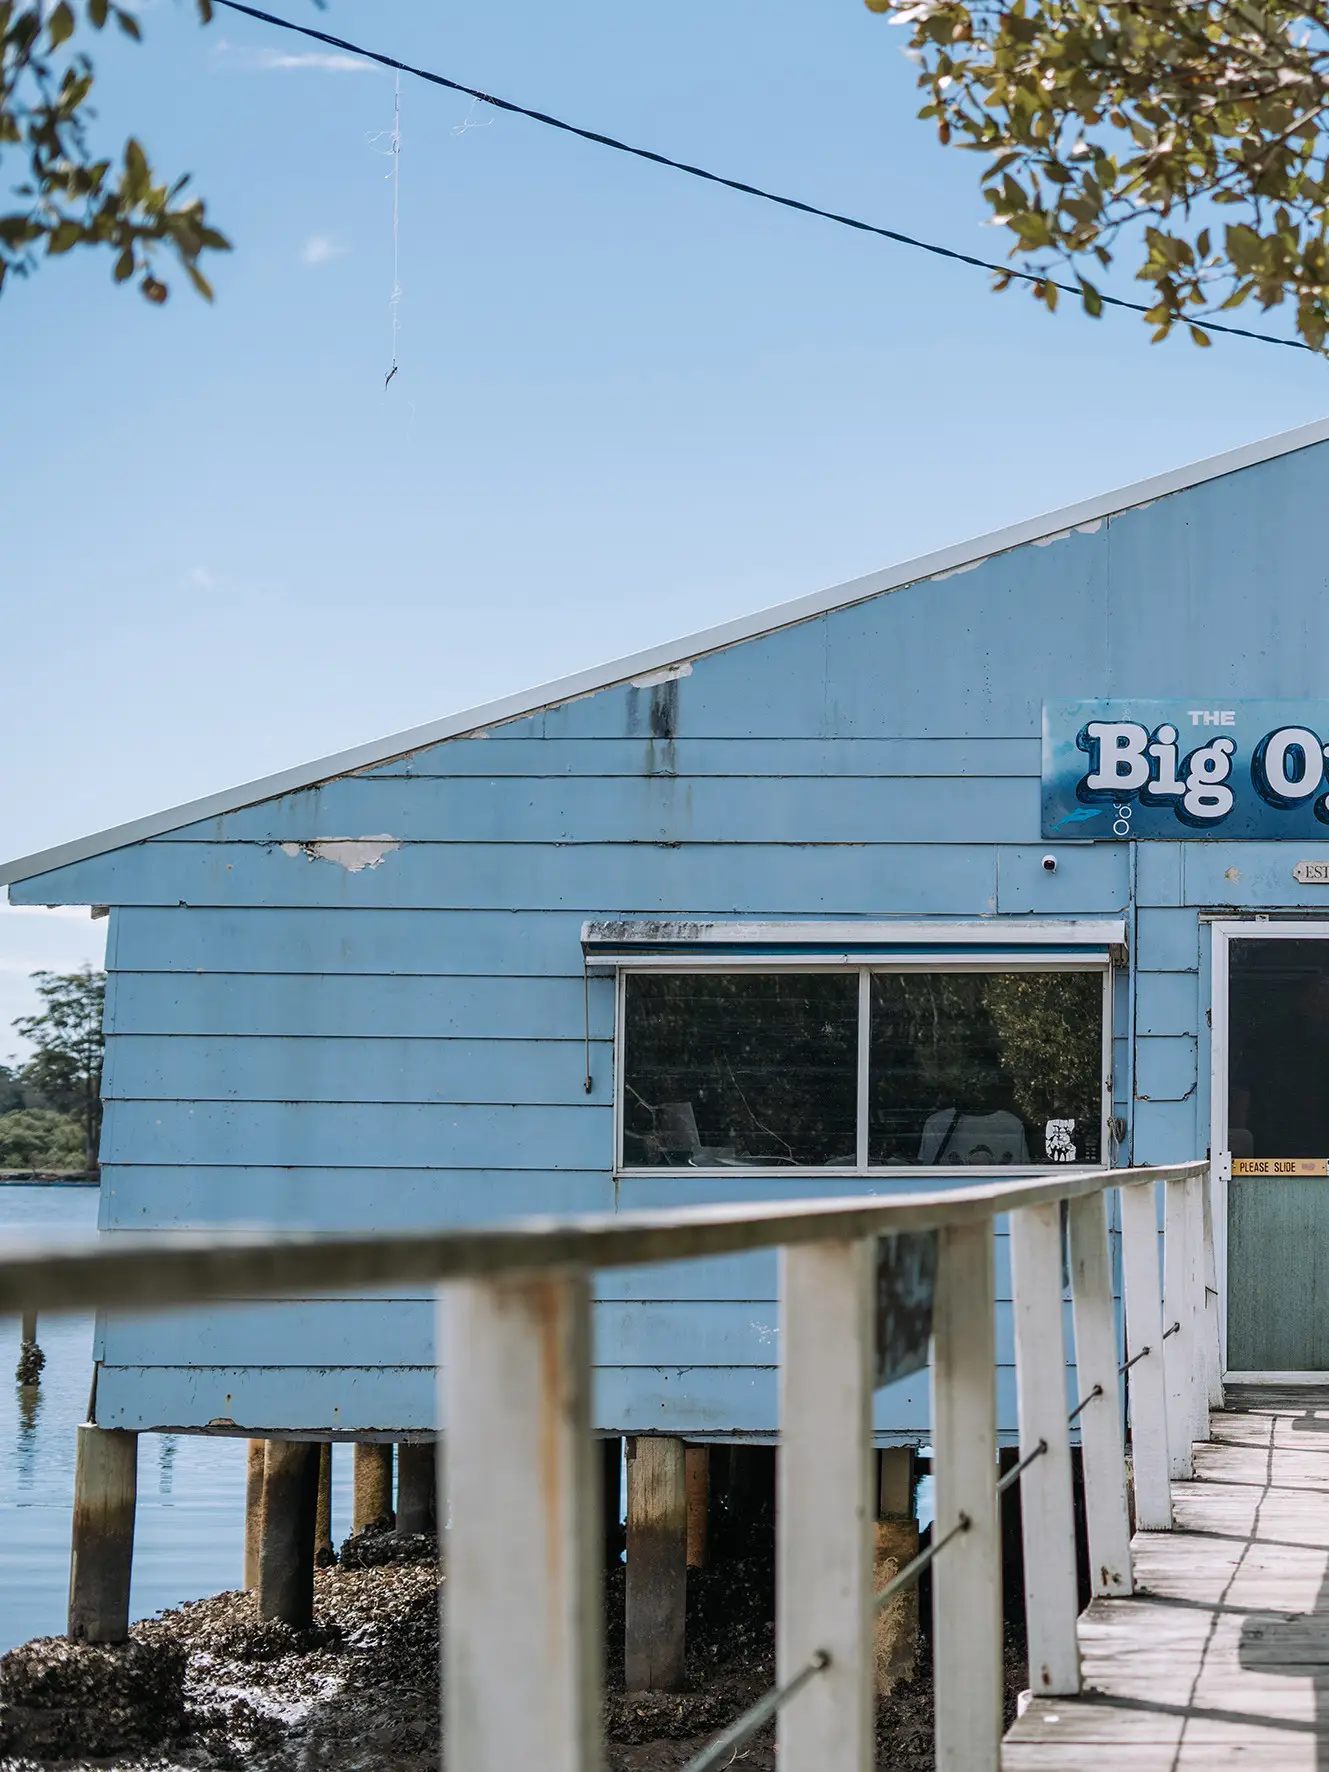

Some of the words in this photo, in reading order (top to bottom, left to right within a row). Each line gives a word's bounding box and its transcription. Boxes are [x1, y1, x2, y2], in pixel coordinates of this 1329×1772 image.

[1187, 710, 1236, 726] THE
[1084, 721, 1236, 819] Big
[1239, 1161, 1269, 1173] PLEASE
[1273, 1161, 1296, 1173] SLIDE
